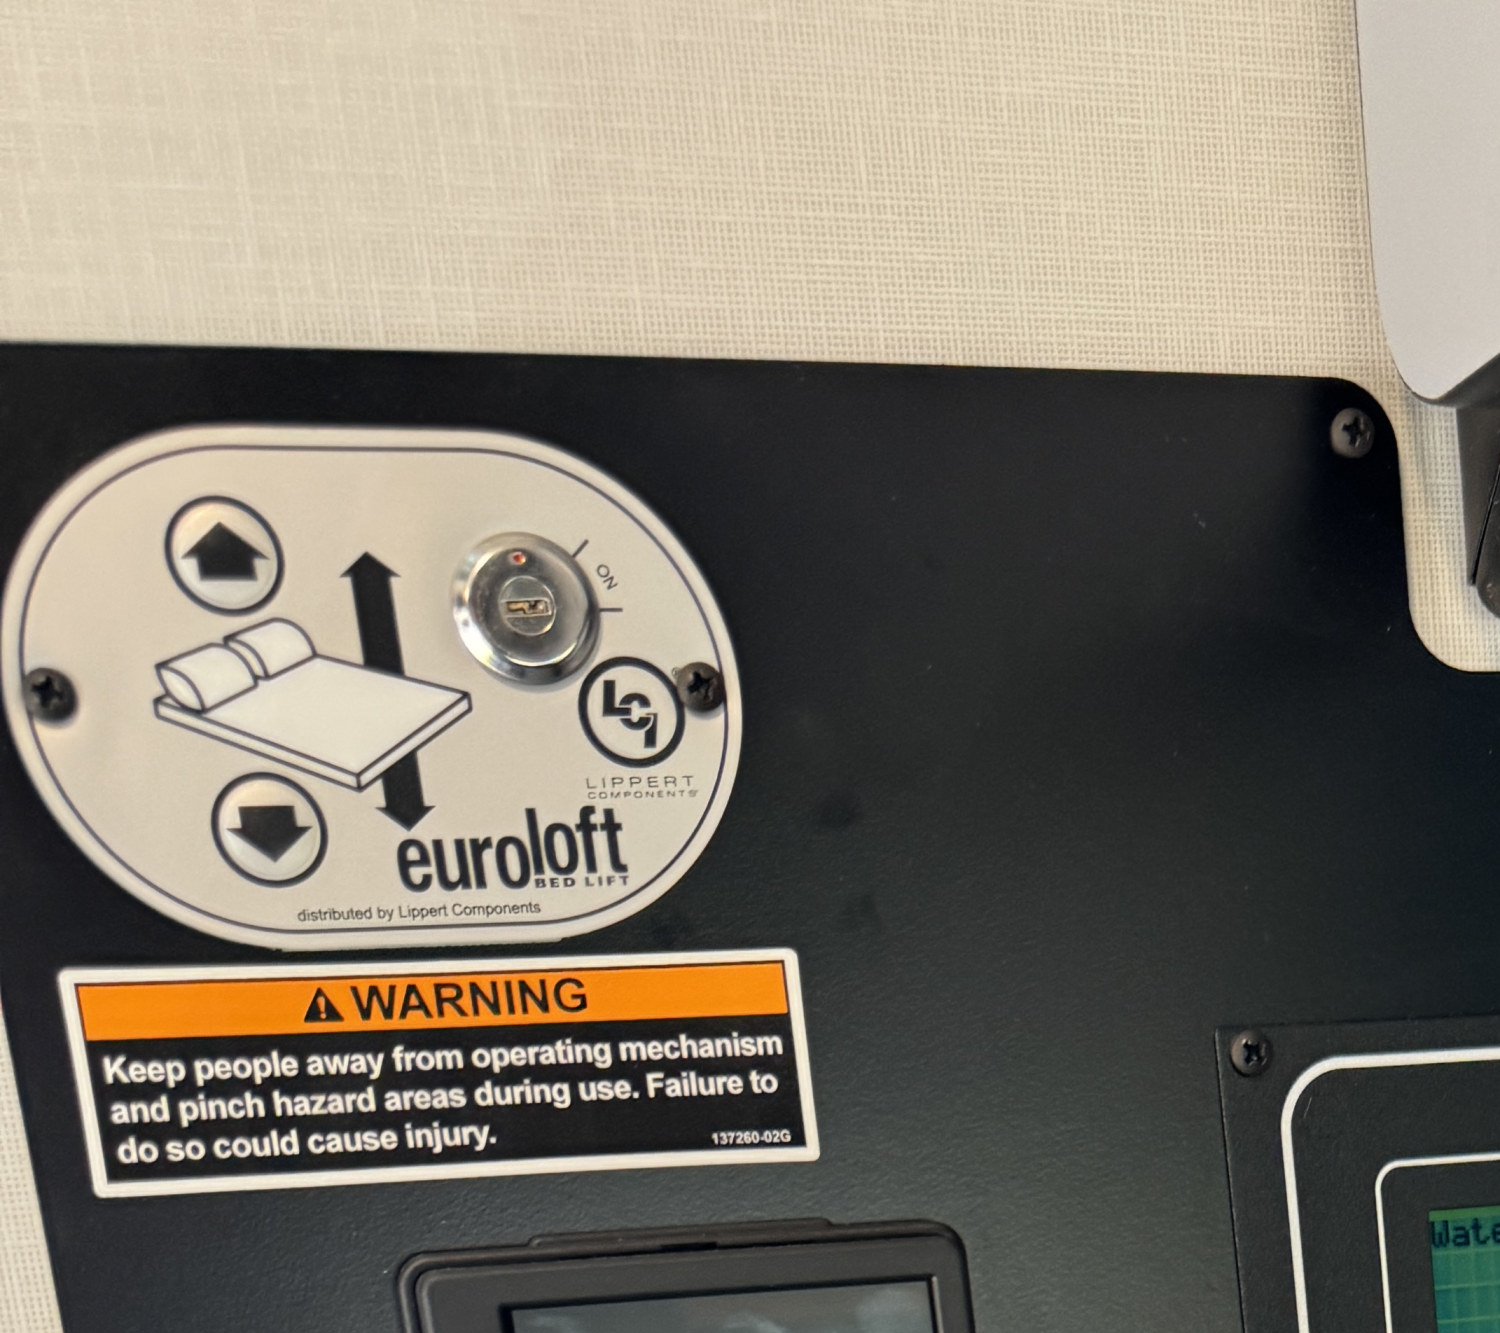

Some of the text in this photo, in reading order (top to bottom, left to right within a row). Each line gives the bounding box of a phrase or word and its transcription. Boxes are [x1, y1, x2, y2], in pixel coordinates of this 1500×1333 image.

[596, 564, 618, 590] ON
[585, 775, 695, 790] LIPPERT
[396, 804, 629, 892] euroloft
[533, 875, 630, 889] BED LIFT
[297, 901, 541, 922] distributed by Lippert Components
[350, 977, 588, 1021] WARNING
[102, 1031, 783, 1088] Keep people away from operating mechanism
[110, 1069, 779, 1128] and pinch hazard areas during use. Failure to
[117, 1120, 497, 1164] do so could cause injury.
[711, 1128, 792, 1146] 137260-02G
